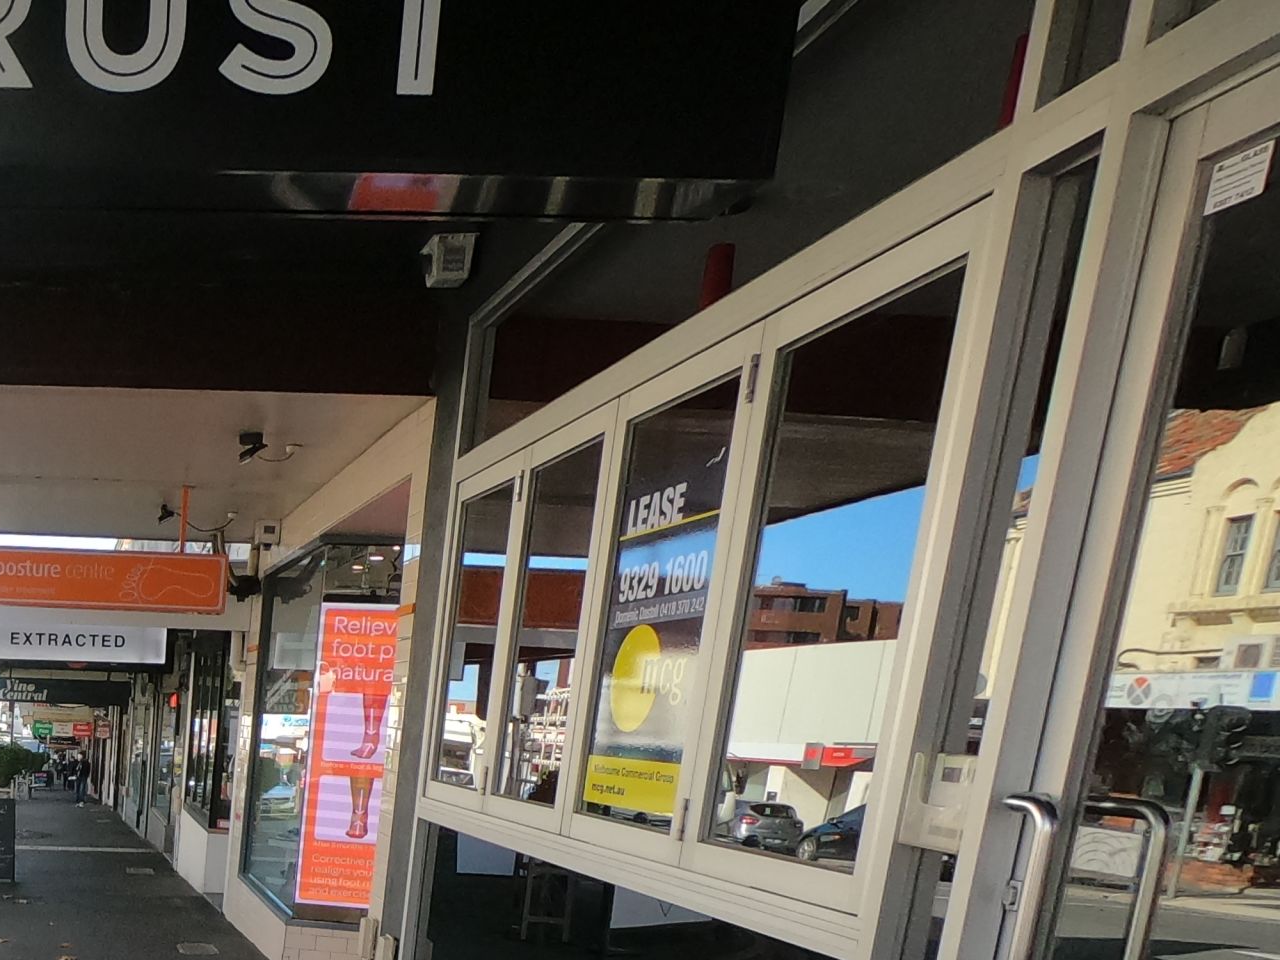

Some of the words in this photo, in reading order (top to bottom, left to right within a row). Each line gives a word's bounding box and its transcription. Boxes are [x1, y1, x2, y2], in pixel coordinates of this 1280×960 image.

[626, 481, 688, 536] LEASE
[618, 560, 659, 603] 9329
[664, 550, 708, 596] 1600
[677, 599, 689, 614] 370
[691, 596, 705, 612] 242
[334, 615, 397, 637] Reliev
[9, 631, 127, 649] EXTRACTED
[331, 638, 376, 658] foot
[379, 645, 395, 664] p
[331, 664, 394, 683] natura
[640, 657, 688, 706] mcg
[0, 687, 49, 701] Central
[5, 679, 36, 692] Vino
[621, 766, 655, 781] Commercial
[656, 770, 674, 784] Group
[591, 782, 625, 796] mcg.net.au
[311, 853, 365, 865] Corrective
[310, 865, 351, 876] realigns
[310, 876, 337, 887] using
[338, 878, 360, 888] foot
[307, 887, 328, 896] and
[330, 889, 368, 899] exercis
